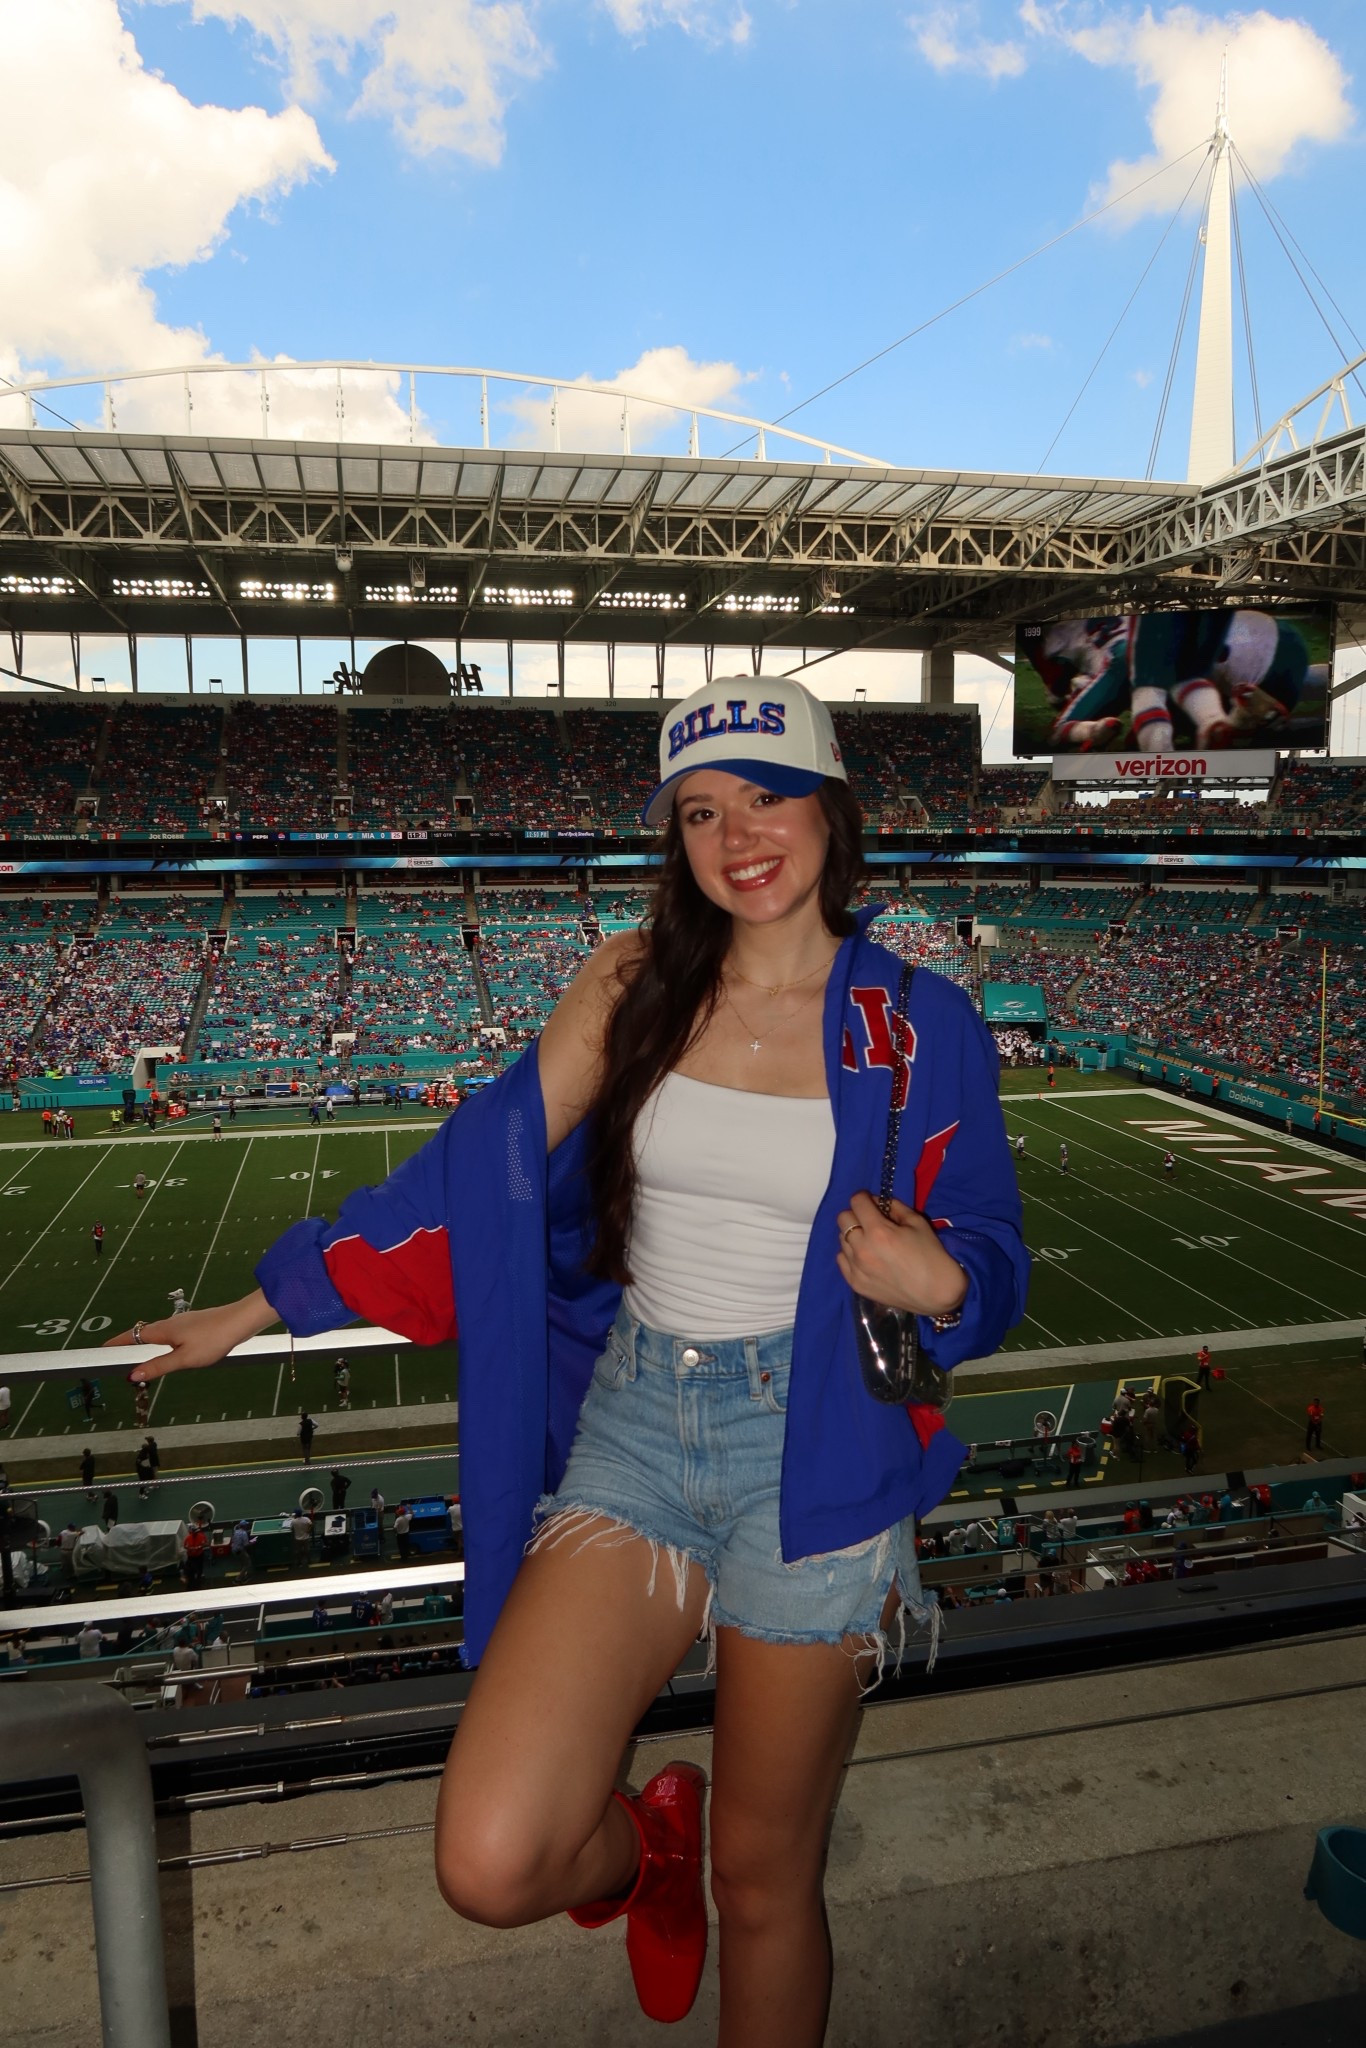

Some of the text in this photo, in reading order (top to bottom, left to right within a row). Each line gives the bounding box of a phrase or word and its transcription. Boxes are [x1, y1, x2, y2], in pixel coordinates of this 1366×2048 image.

[1024, 626, 1041, 637] 1999
[668, 700, 785, 761] BILLS
[1115, 755, 1207, 776] verizon
[1228, 1090, 1265, 1108] Dolphins
[289, 1169, 341, 1181] 40
[1171, 1235, 1230, 1250] 10
[34, 1315, 113, 1336] 30
[1002, 1526, 1012, 1537] 17
[356, 1608, 365, 1619] 17
